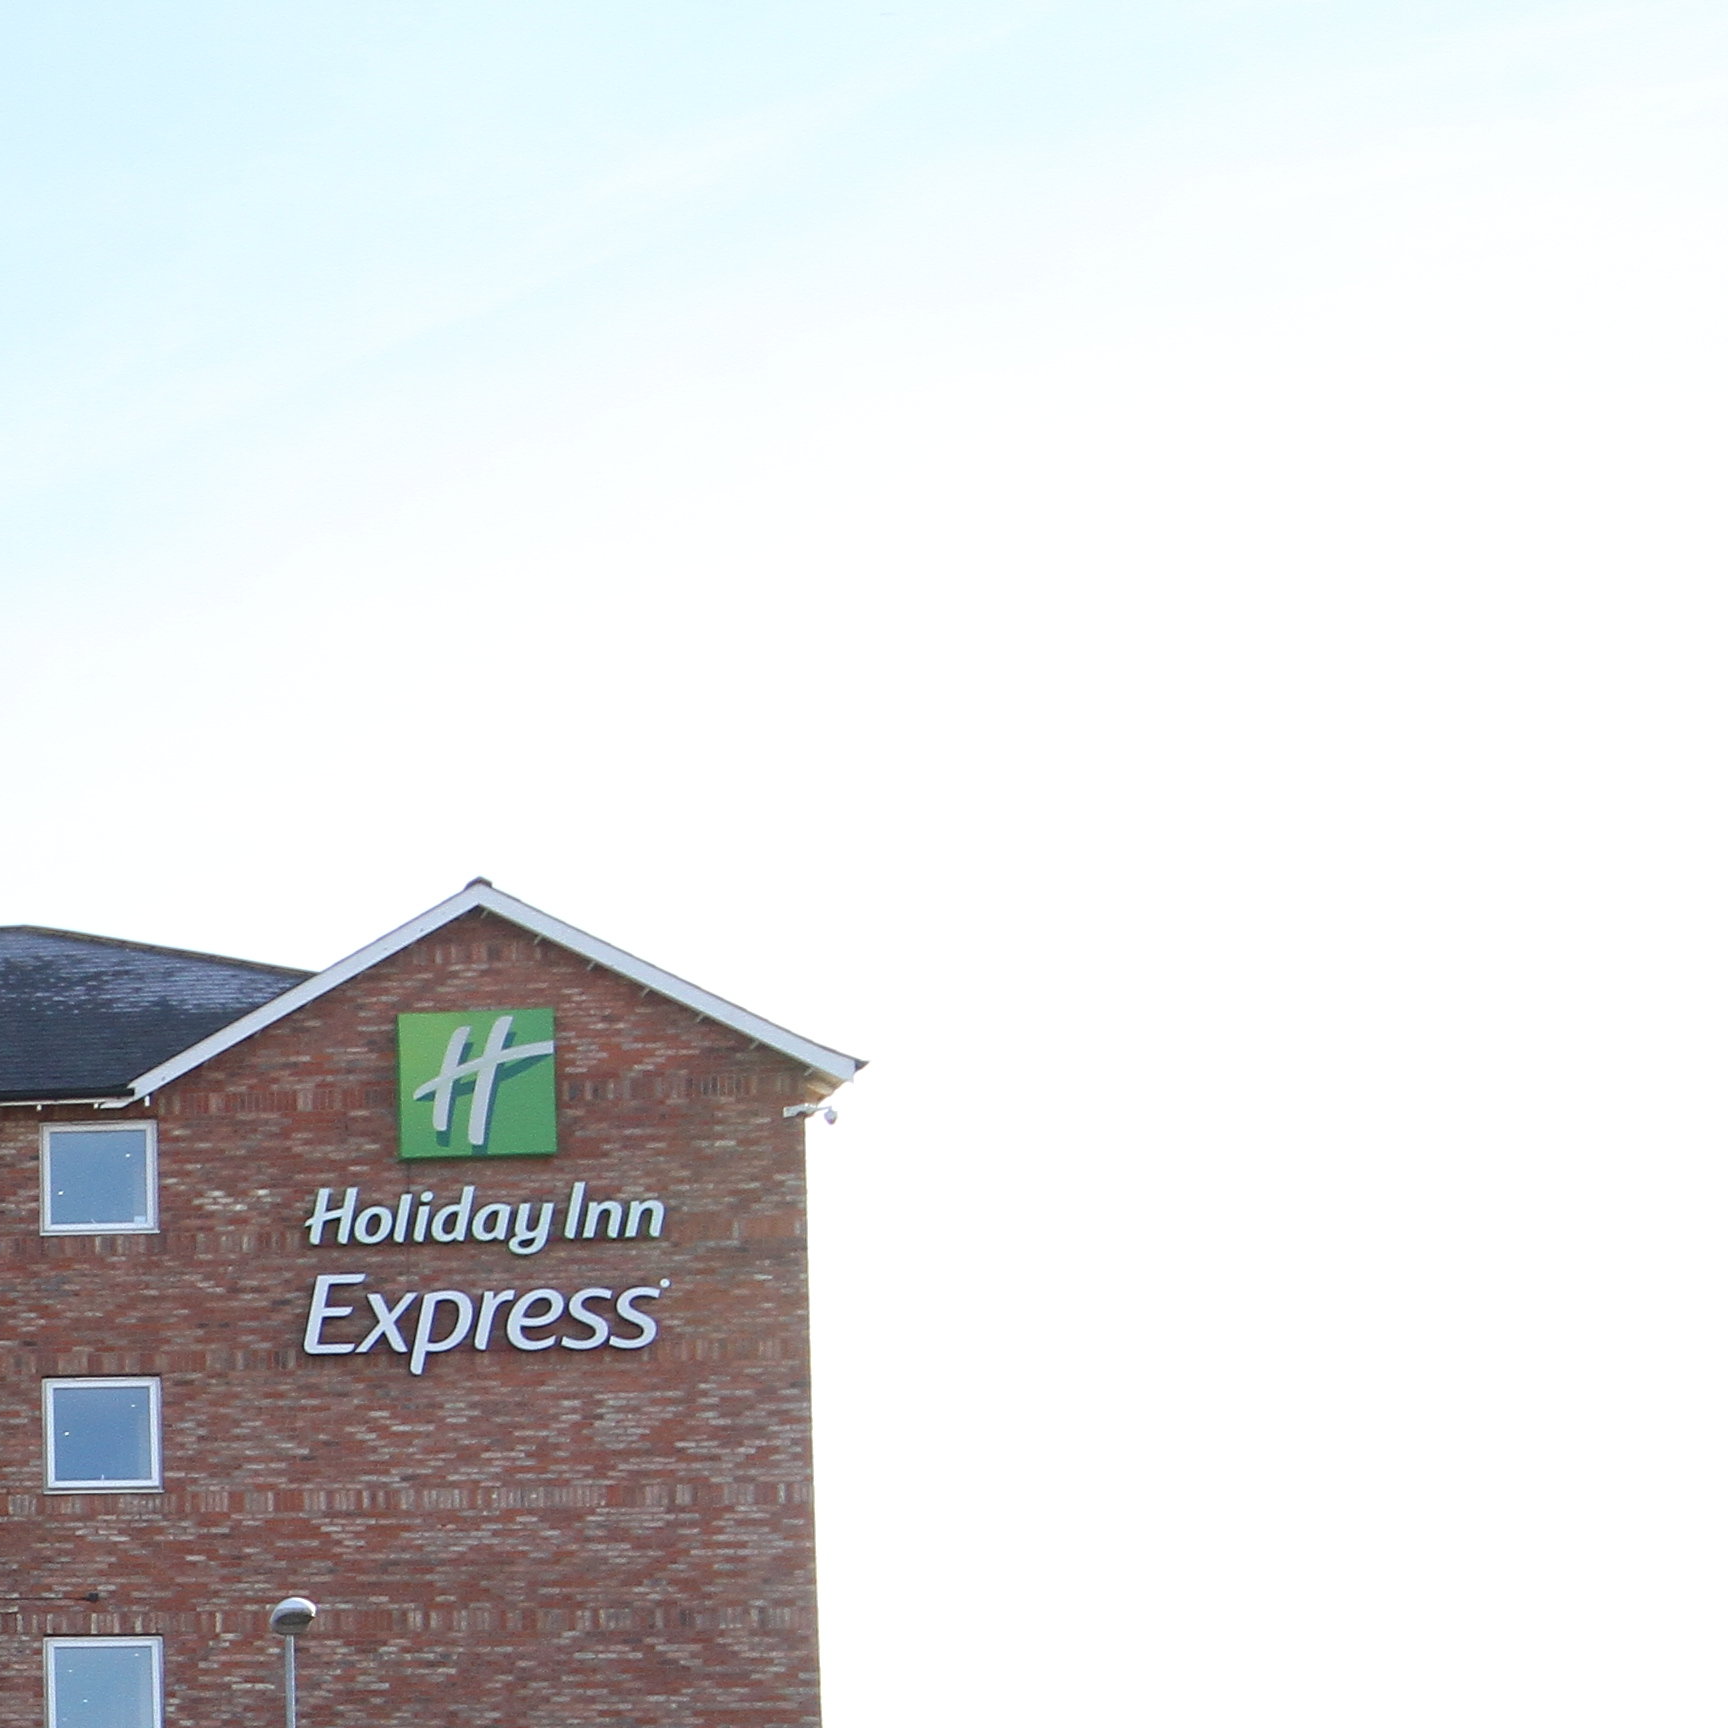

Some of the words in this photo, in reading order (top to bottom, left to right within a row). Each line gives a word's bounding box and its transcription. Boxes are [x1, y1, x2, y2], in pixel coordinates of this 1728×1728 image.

[304, 1185, 554, 1255] Holiday
[563, 1181, 665, 1241] Inn
[303, 1273, 661, 1375] Express
